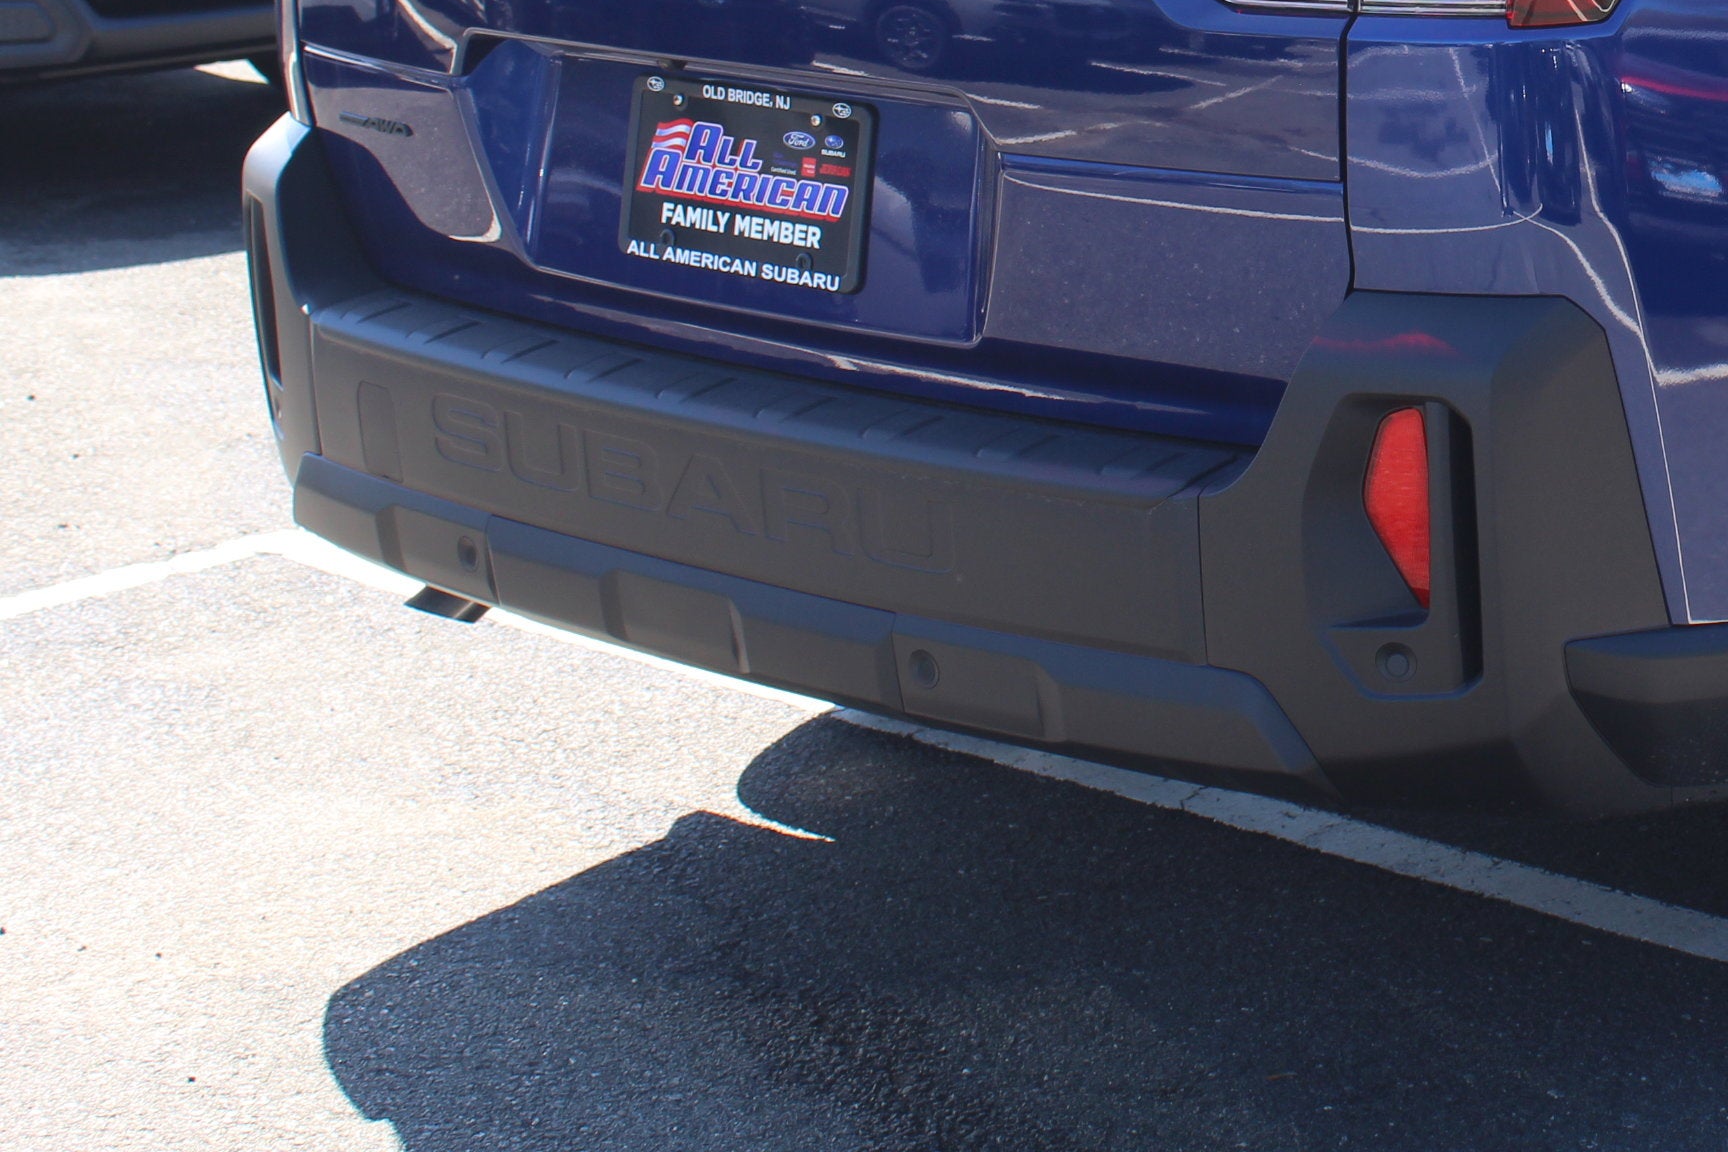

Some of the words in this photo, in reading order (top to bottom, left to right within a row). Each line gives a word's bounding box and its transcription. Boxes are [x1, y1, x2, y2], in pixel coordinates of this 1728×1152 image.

[702, 84, 725, 100] OLD
[727, 88, 773, 107] BRIDGE,
[775, 96, 791, 109] NJ
[639, 147, 849, 219] AMERICAN
[661, 202, 730, 234] FAMILY
[734, 215, 821, 249] MEMBER
[626, 240, 660, 259] ALL
[662, 249, 757, 277] AMERICAN
[761, 264, 840, 291] SUBARU
[433, 393, 955, 573] SUBARU
